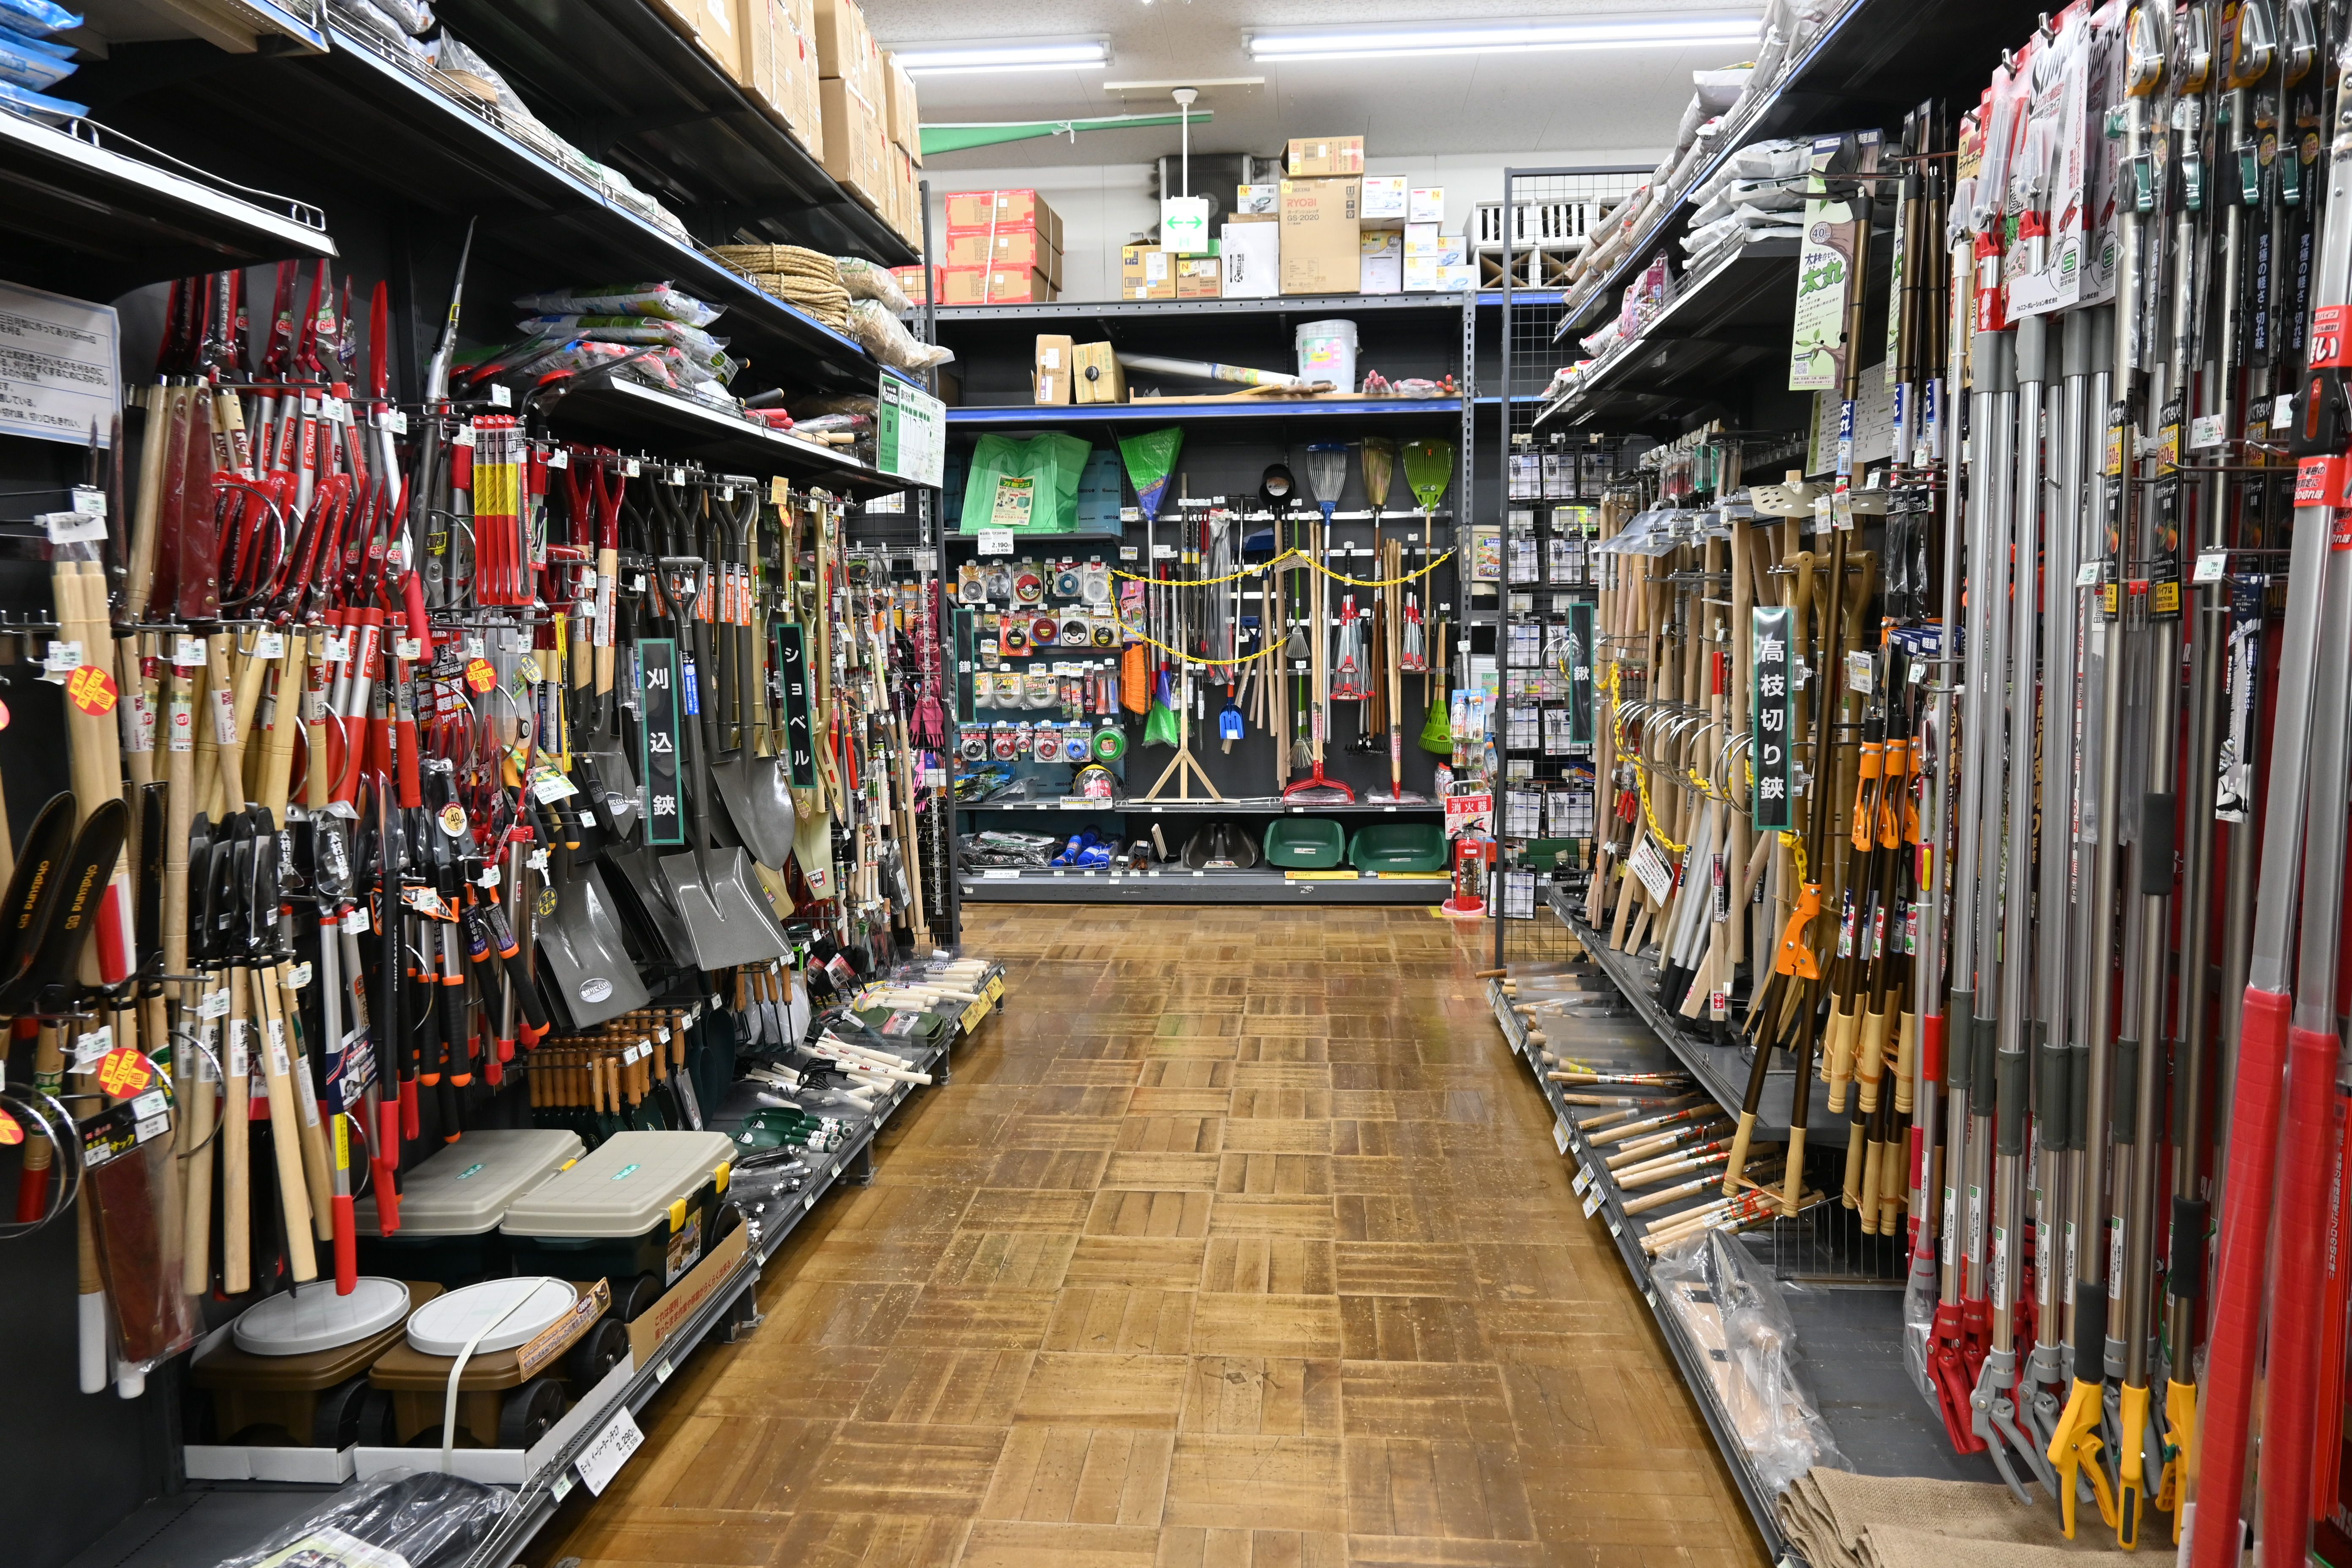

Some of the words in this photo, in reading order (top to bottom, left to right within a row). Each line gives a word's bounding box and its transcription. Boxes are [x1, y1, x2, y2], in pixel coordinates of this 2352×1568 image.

[1287, 198, 1316, 207] RYOBI
[959, 660, 971, 673] 鎌
[468, 669, 493, 680] うれしい
[784, 647, 809, 765] ショベル
[1761, 640, 1785, 800] 高枝切り鋏
[646, 668, 675, 816] 刈込鋏
[1451, 801, 1487, 814] 消火器
